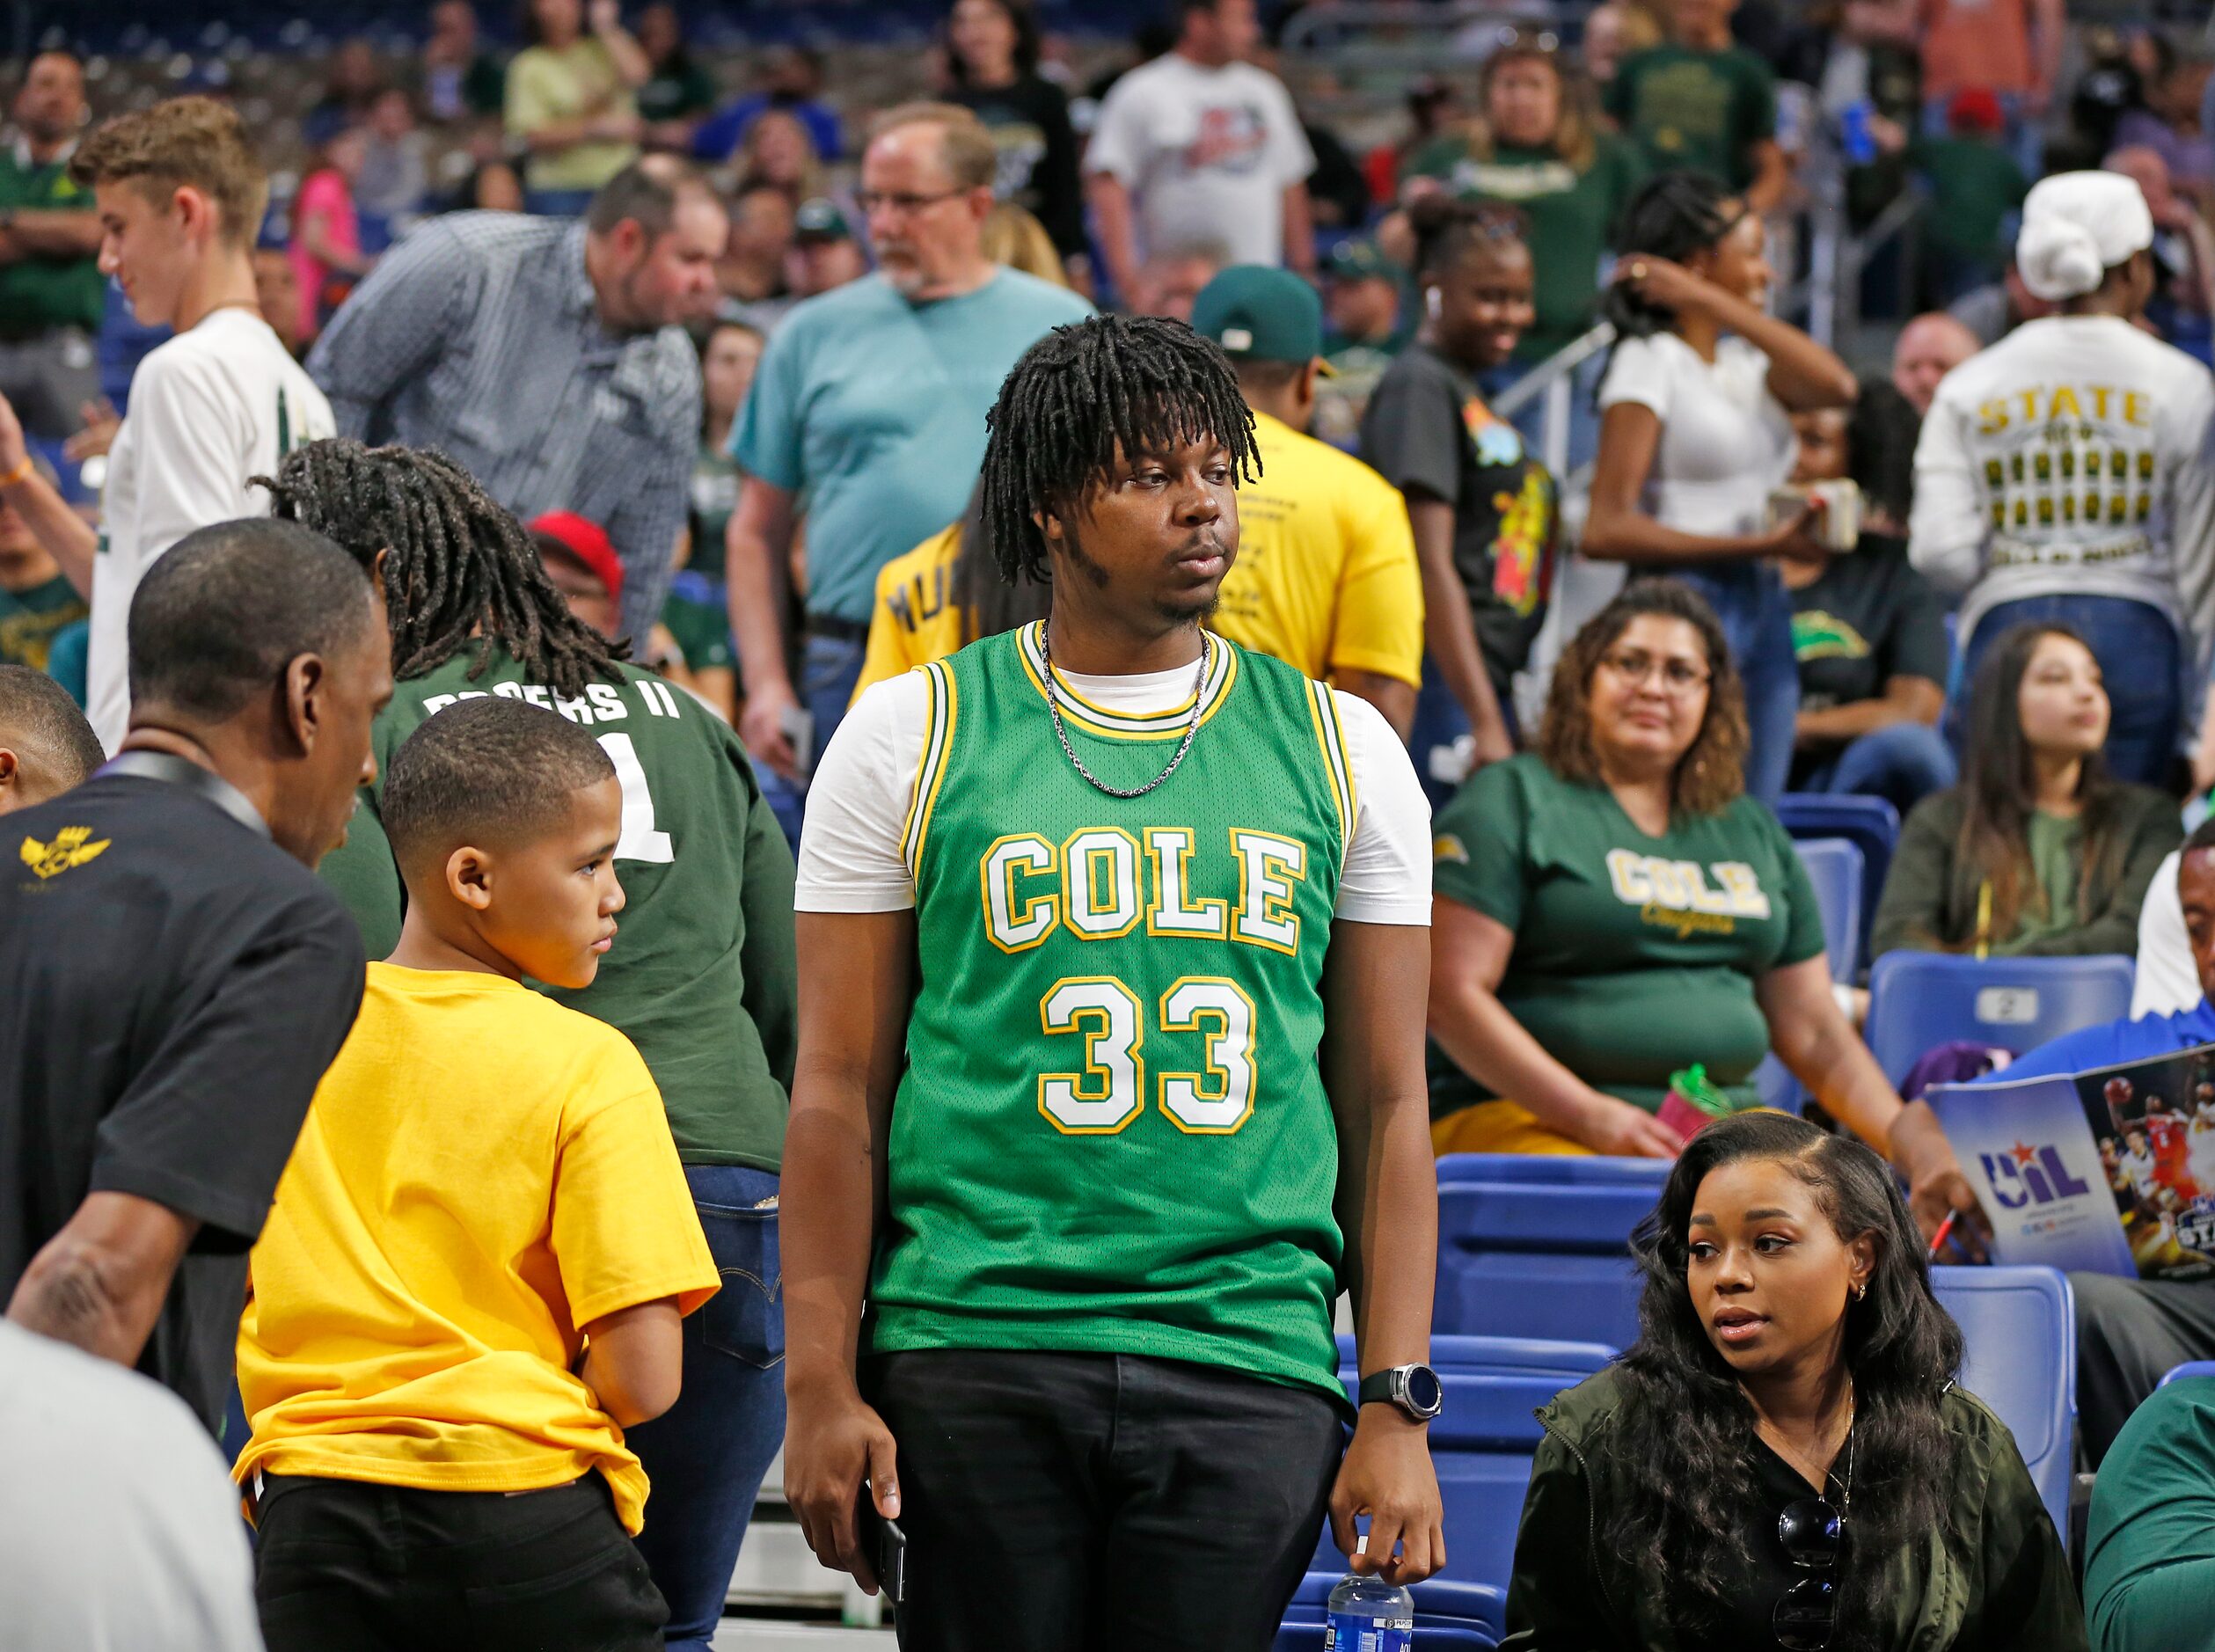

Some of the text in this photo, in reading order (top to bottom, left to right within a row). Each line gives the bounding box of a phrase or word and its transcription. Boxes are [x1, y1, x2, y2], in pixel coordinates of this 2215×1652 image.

[1978, 384, 2153, 436] STATE
[422, 681, 628, 726] RERS
[979, 826, 1307, 958] COLE
[1605, 847, 1773, 920] COLE
[1998, 990, 2016, 1018] 2
[1037, 975, 1257, 1137] 33
